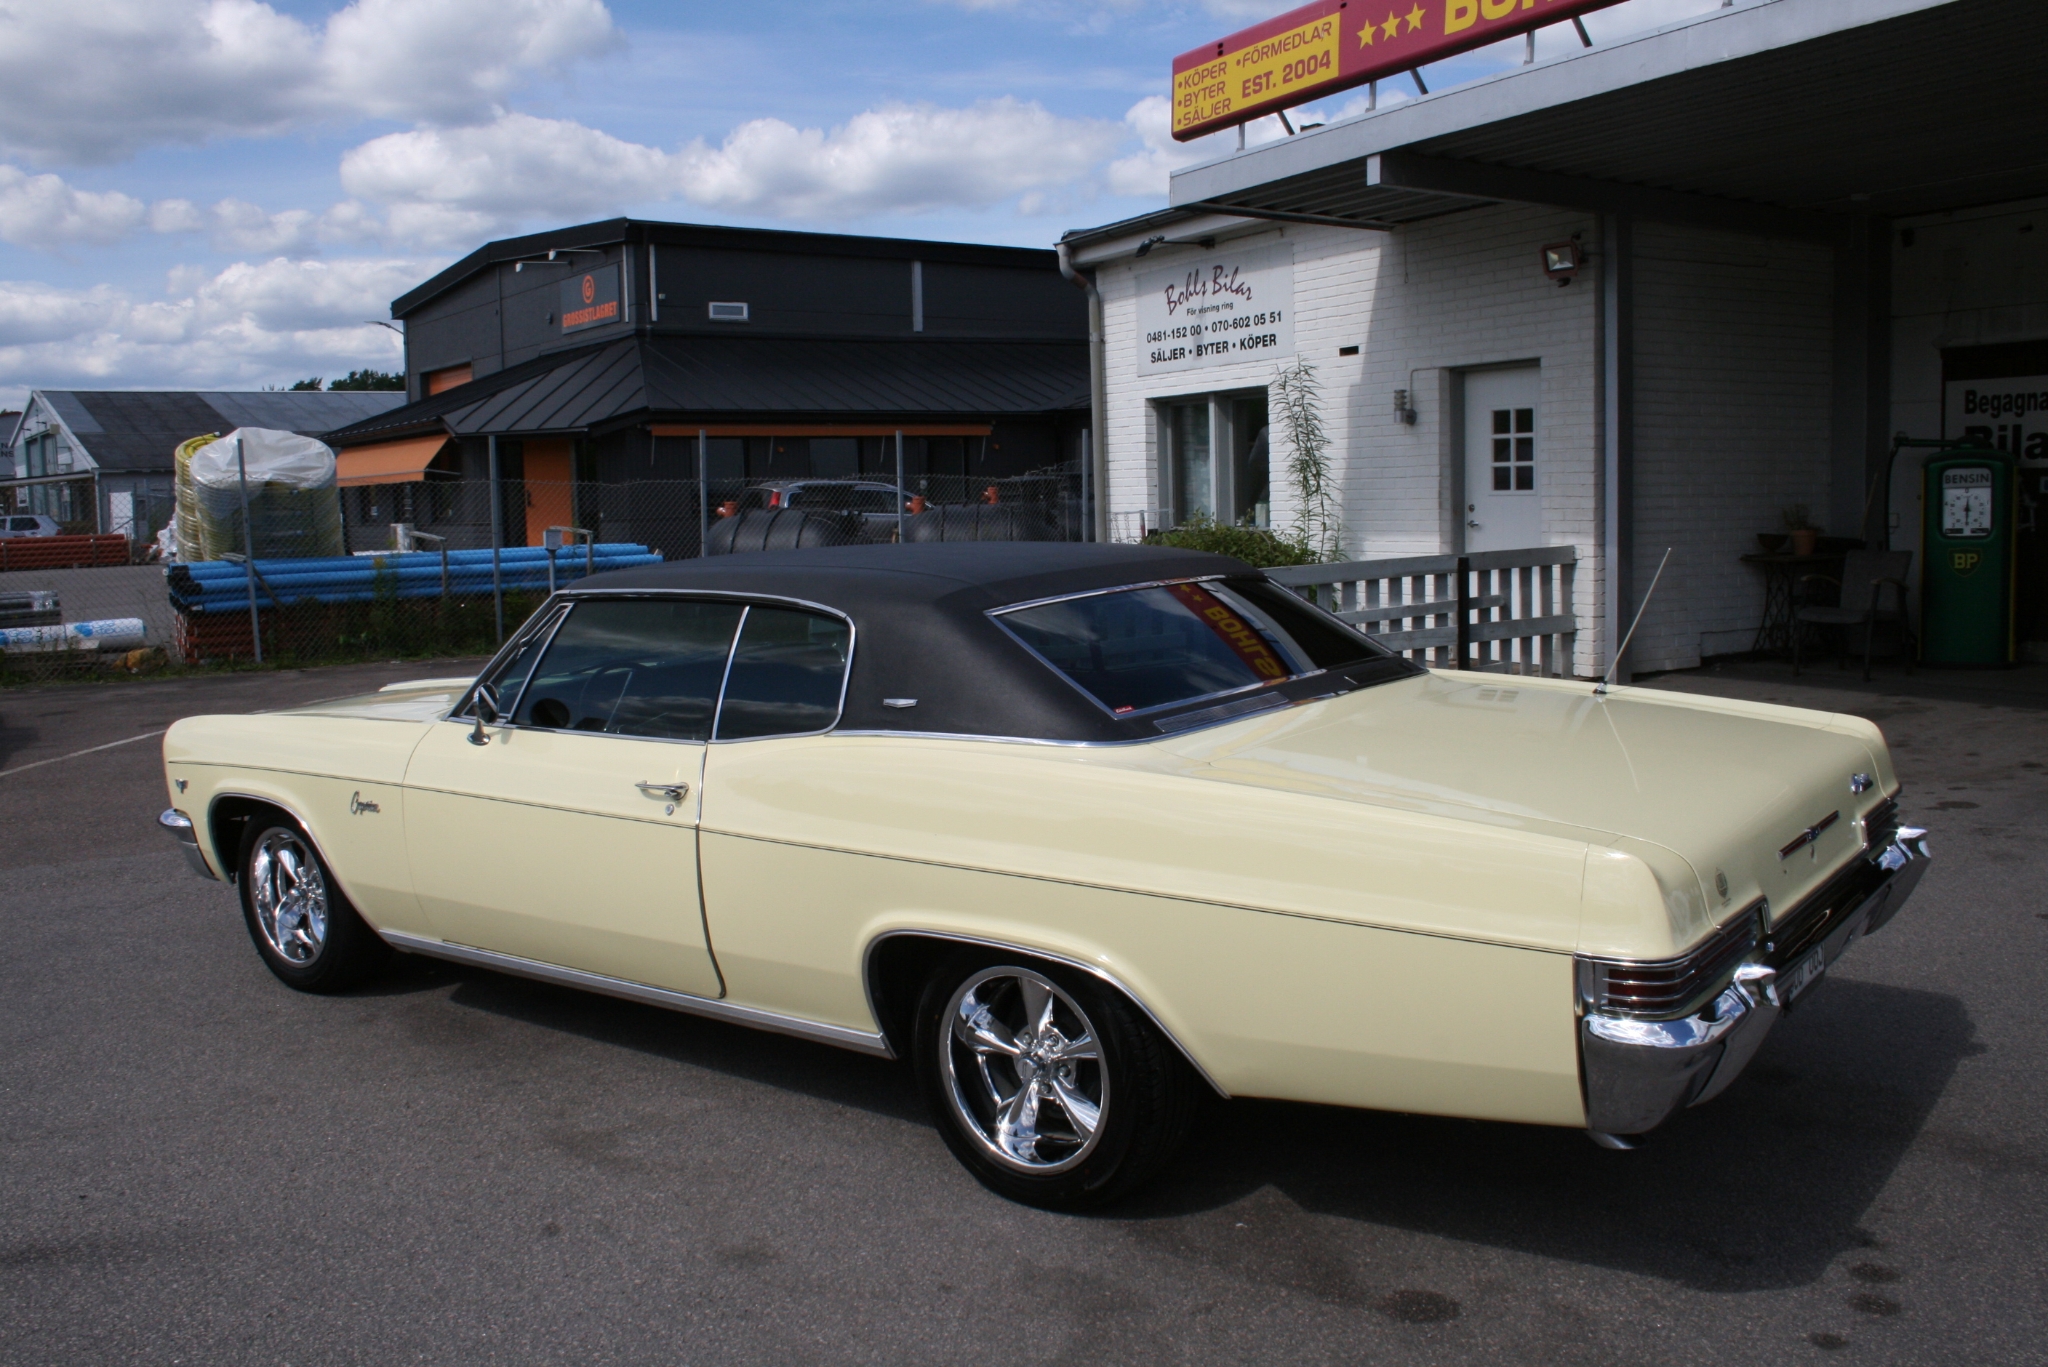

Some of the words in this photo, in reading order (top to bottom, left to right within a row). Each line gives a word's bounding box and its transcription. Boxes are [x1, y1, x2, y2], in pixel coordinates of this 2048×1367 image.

[1183, 60, 1228, 90] KÖPER
[1242, 21, 1332, 67] FÖRMEDLAR
[1241, 71, 1277, 99] EST.
[1282, 49, 1331, 86] 2004
[1183, 80, 1226, 109] BYTER
[1183, 97, 1231, 127] SÄLJER
[1212, 265, 1252, 301] Bilar
[1186, 308, 1197, 316] För
[1198, 303, 1219, 314] visning
[1221, 302, 1233, 311] ring
[1146, 326, 1187, 343] 0481-152
[1190, 324, 1202, 336] 00
[1211, 316, 1251, 333] 070-602
[1253, 313, 1266, 326] 05
[1269, 311, 1282, 323] 51
[1150, 347, 1186, 364] SÄLJER
[1196, 340, 1229, 357] BYTER
[1239, 333, 1277, 351] KÖPER
[1944, 473, 1990, 484] BENSIN
[1953, 553, 1979, 569] BP
